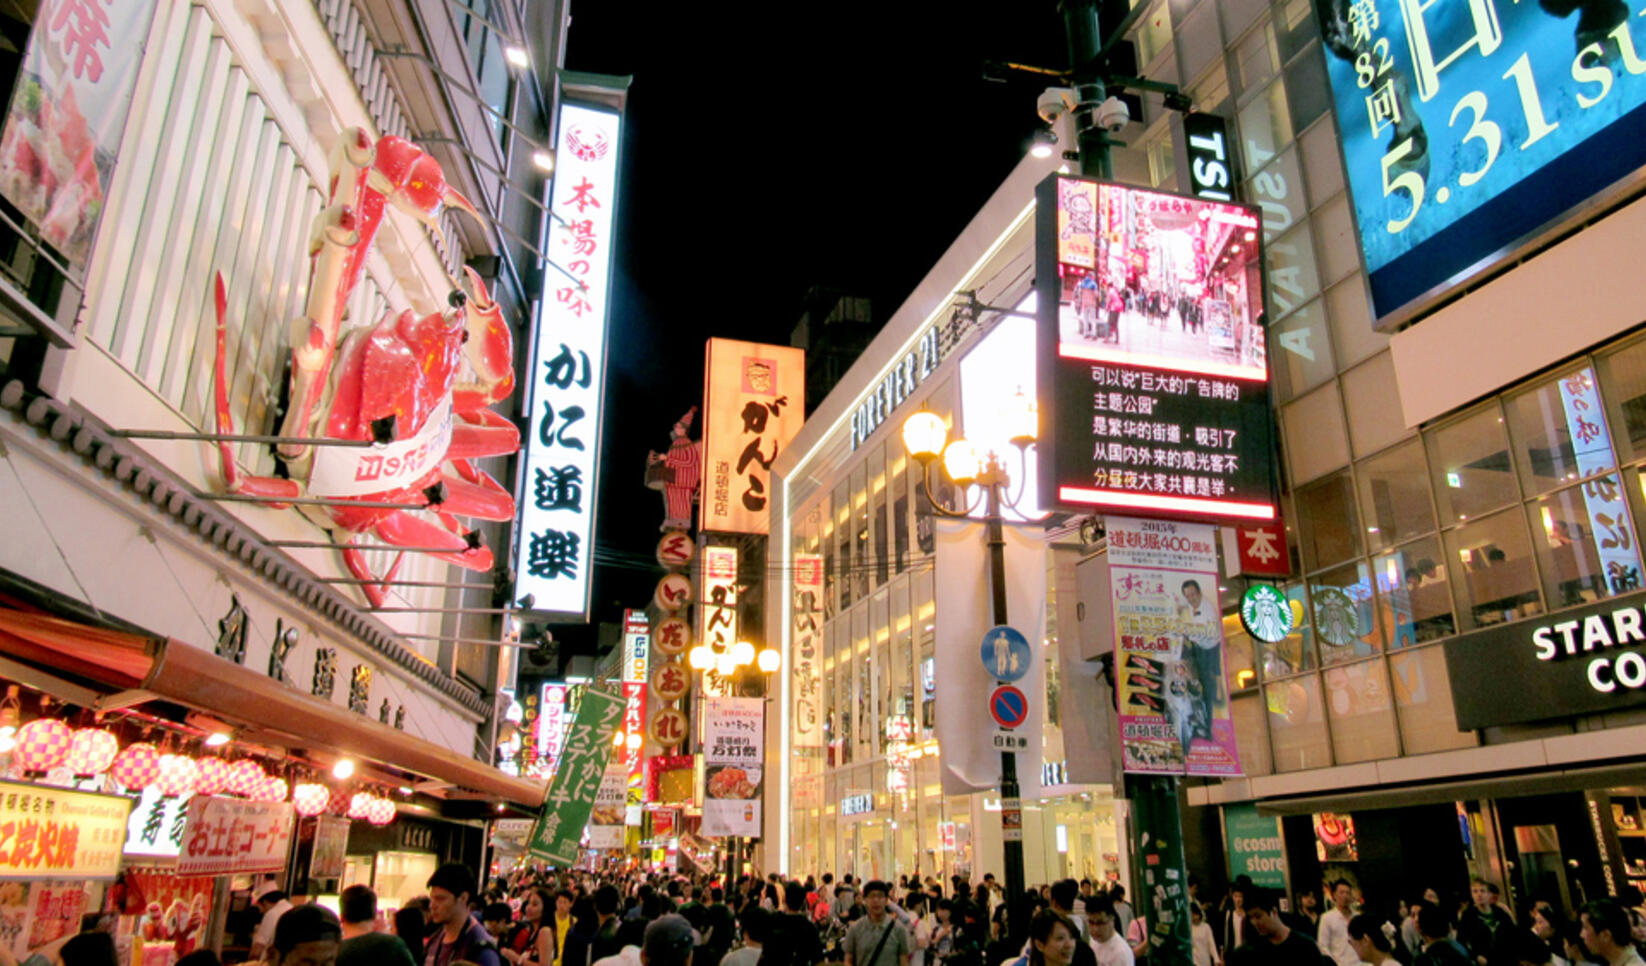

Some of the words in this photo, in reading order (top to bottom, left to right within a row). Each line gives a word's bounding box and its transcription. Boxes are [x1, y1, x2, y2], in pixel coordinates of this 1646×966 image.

[1381, 51, 1559, 234] 5.31
[556, 176, 601, 319] 本場の味
[851, 352, 917, 451] FOREVER
[920, 325, 940, 381] 21
[736, 395, 788, 512] がんこ
[1141, 521, 1177, 535] 2015年
[1244, 528, 1280, 565] 本
[655, 536, 689, 740] くいだおれ
[1532, 605, 1646, 660] STAR
[573, 701, 622, 804] タラバかに
[994, 735, 1027, 748] 自動車
[1246, 854, 1284, 872] store
